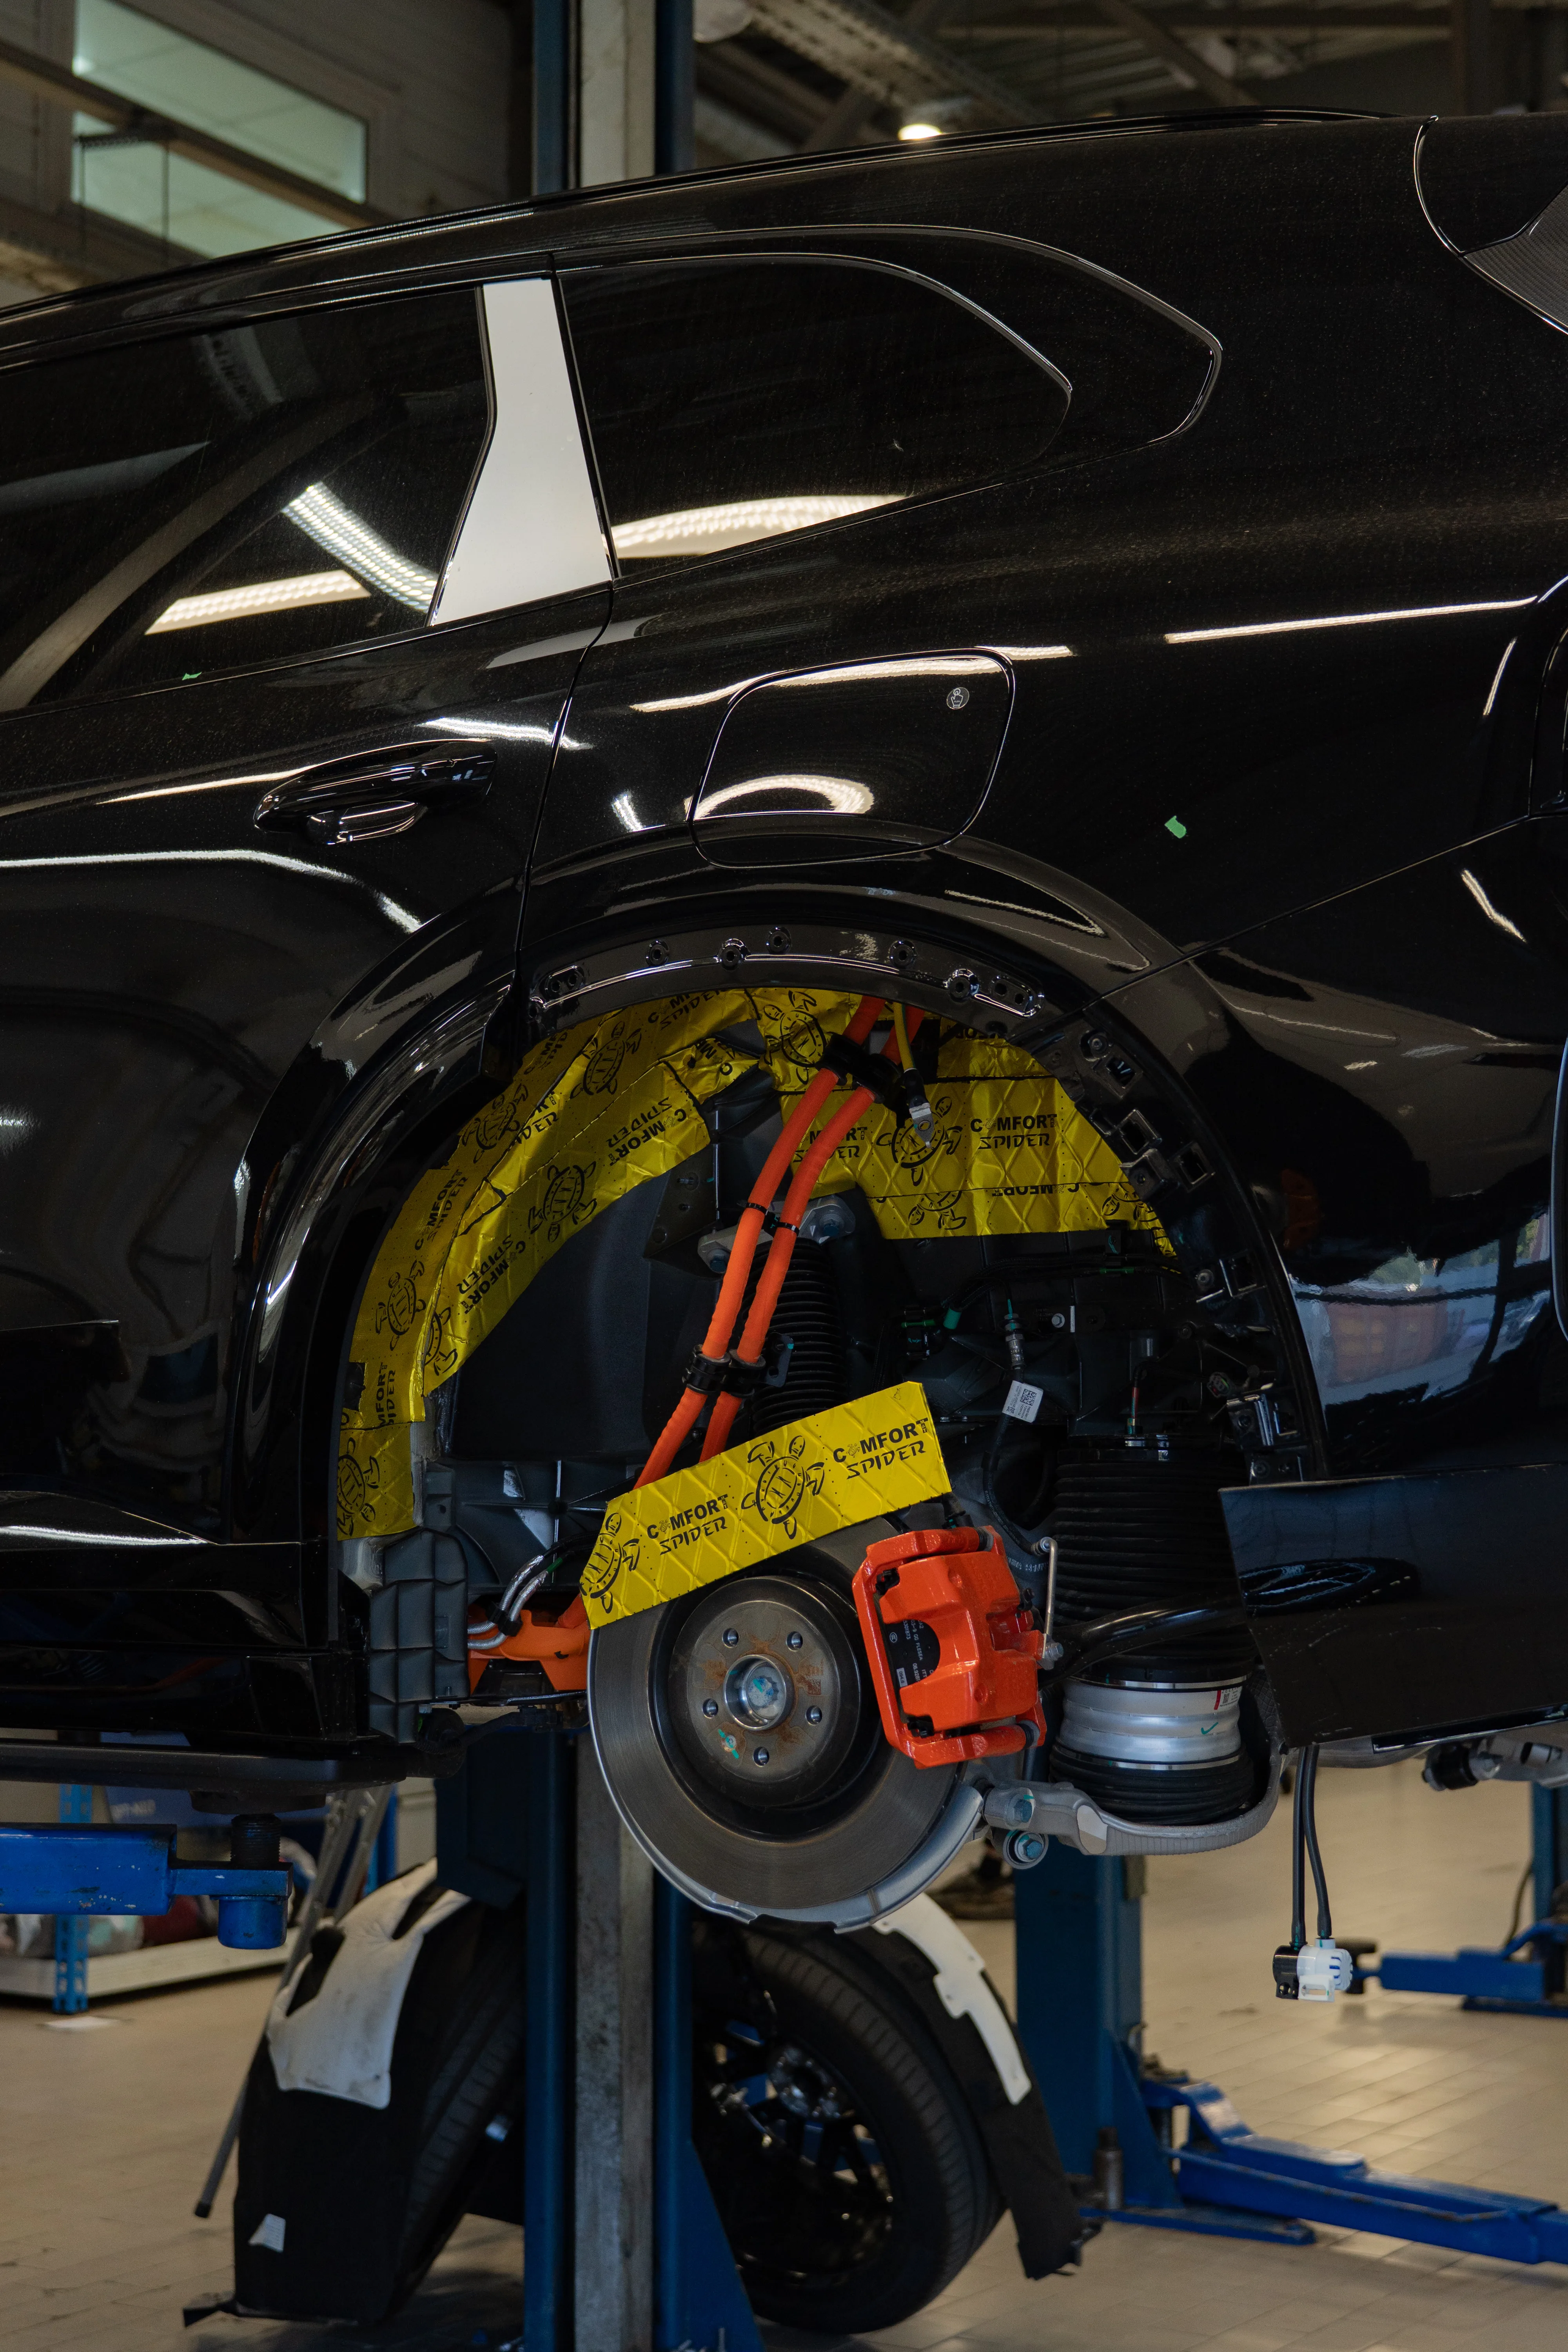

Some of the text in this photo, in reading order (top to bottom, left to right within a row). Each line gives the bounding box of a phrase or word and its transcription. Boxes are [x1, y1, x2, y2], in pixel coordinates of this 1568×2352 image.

[606, 1096, 672, 1147] SPIDER
[978, 1133, 1050, 1149] SPIDER
[456, 1234, 513, 1294] SPIDER
[847, 1440, 926, 1479] SPIDER
[659, 1516, 728, 1555] SPIDER
